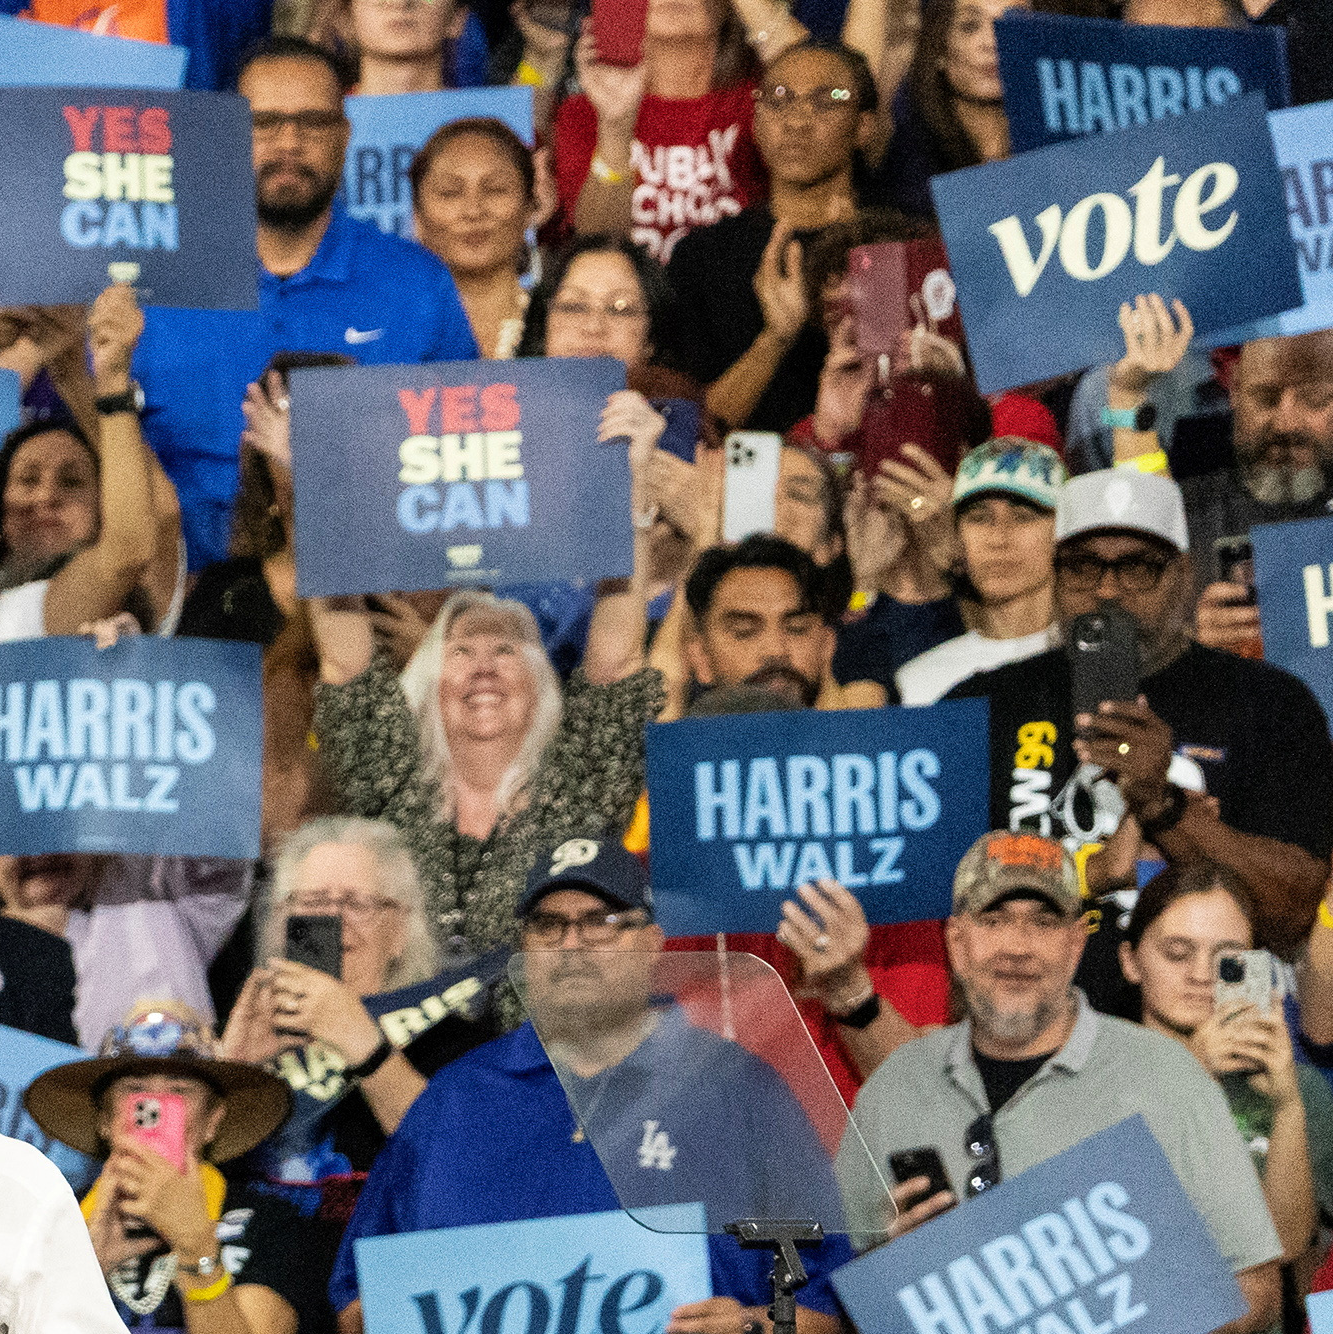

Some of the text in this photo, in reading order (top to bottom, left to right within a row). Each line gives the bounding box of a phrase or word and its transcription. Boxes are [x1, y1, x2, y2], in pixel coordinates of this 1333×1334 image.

[62, 106, 173, 153] YES
[63, 153, 175, 203] SHE
[61, 203, 178, 251] CAN
[989, 158, 1240, 297] vote
[398, 384, 521, 435] YES
[398, 432, 523, 485] SHE
[397, 483, 530, 532] CAN
[13, 764, 179, 813] WALZ
[695, 749, 943, 841] HARRIS
[734, 837, 905, 893] WALZ
